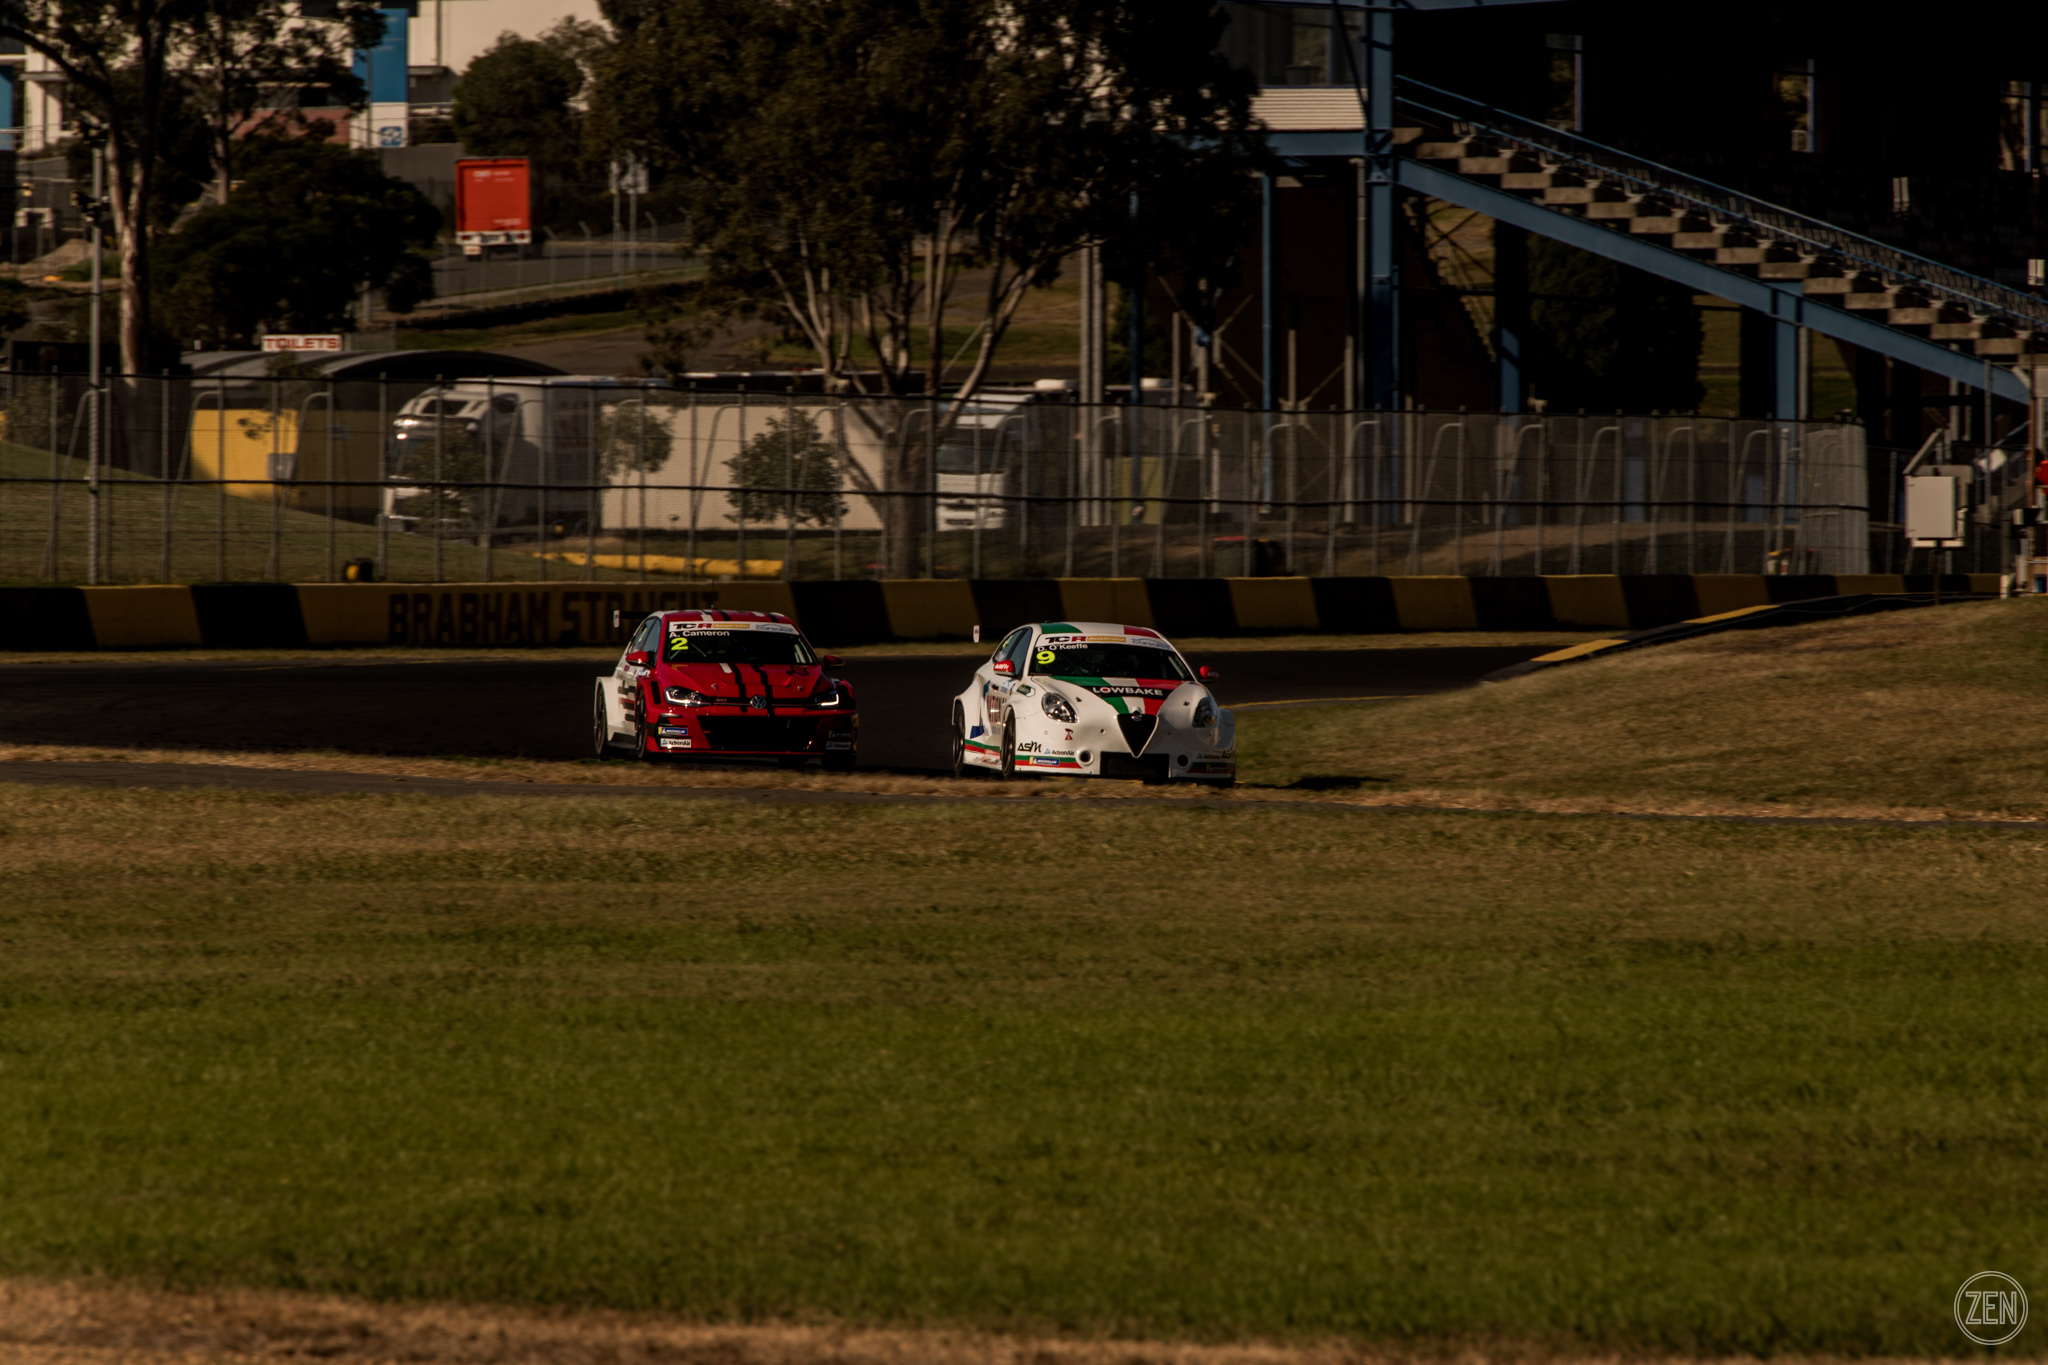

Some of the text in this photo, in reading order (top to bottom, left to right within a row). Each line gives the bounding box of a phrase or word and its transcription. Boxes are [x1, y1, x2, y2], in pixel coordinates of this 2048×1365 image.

[263, 338, 338, 349] TOILETS
[390, 592, 550, 643] BRABHAM
[670, 637, 689, 651] 2
[1045, 636, 1087, 644] TCR
[1049, 643, 1088, 651] O'Keeffe
[1036, 650, 1056, 665] 9
[1092, 686, 1163, 696] LOWBAKE
